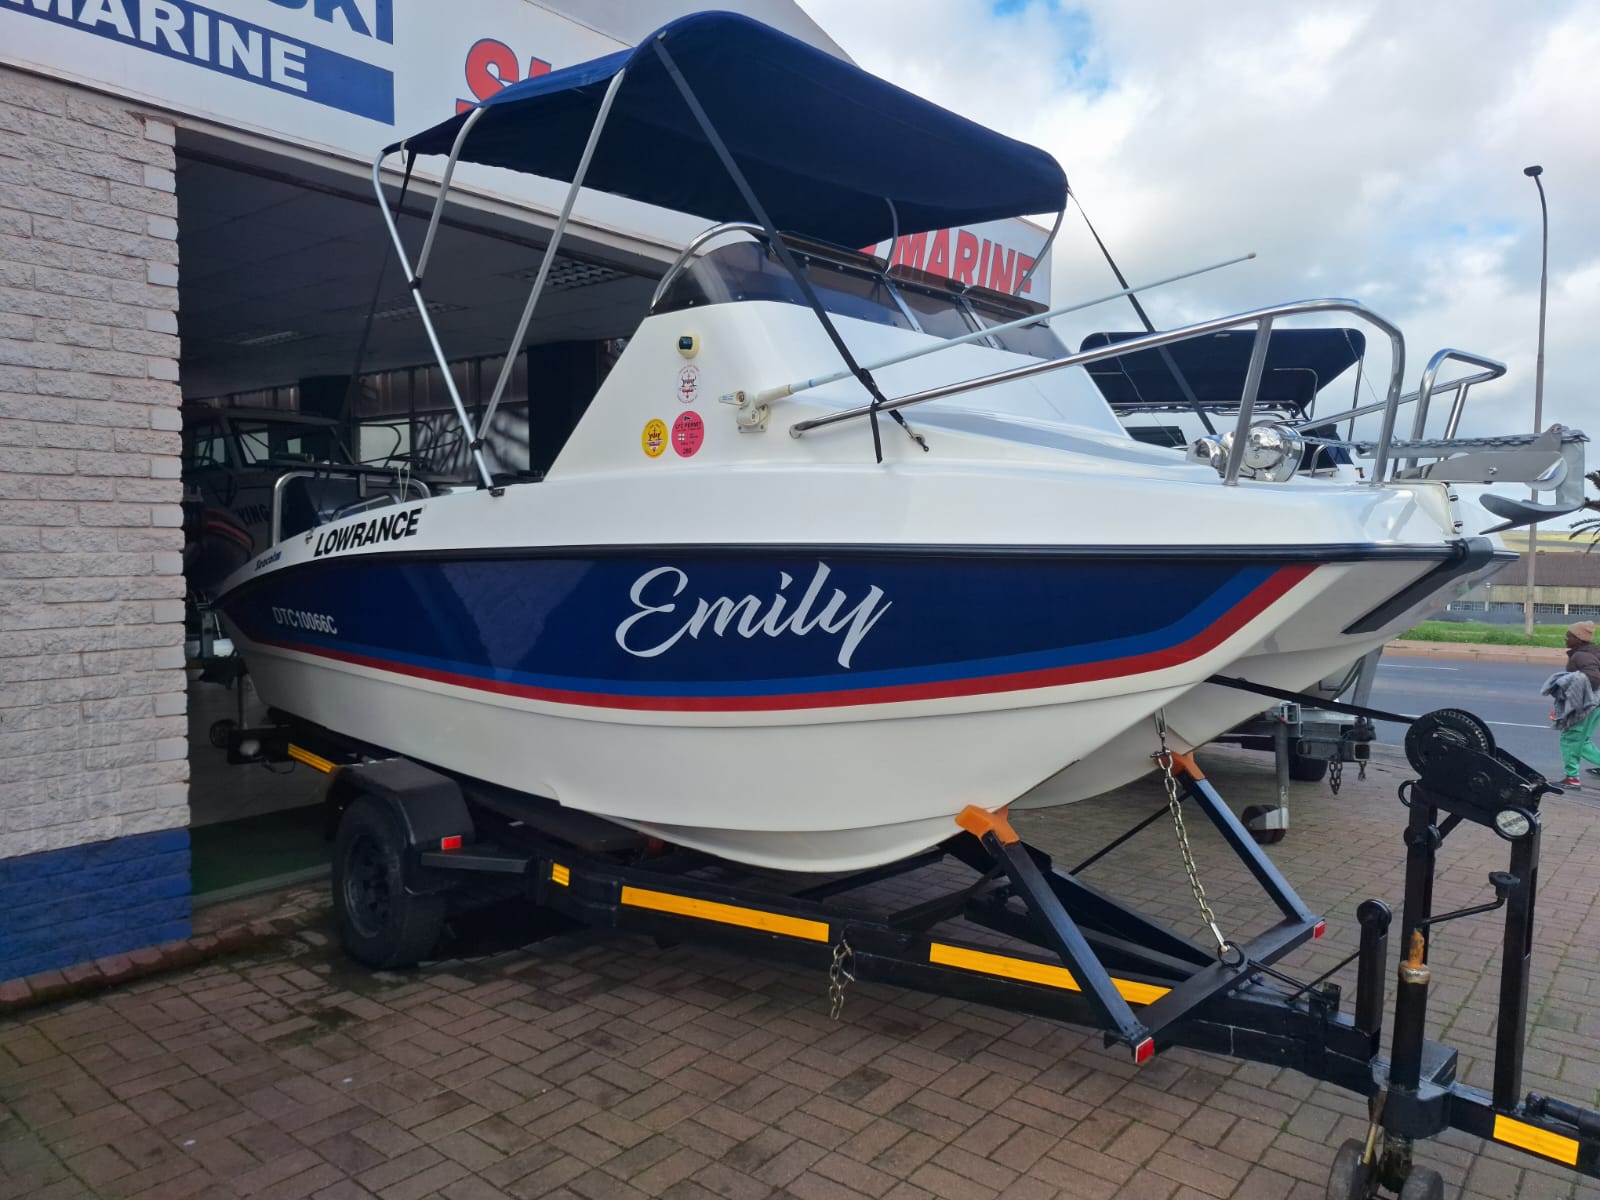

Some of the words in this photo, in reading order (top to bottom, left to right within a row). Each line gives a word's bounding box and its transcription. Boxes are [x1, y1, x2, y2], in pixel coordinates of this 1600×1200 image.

[313, 508, 423, 557] LOWRANCE
[271, 606, 338, 635] DTC10066C
[615, 560, 893, 669] Emily
